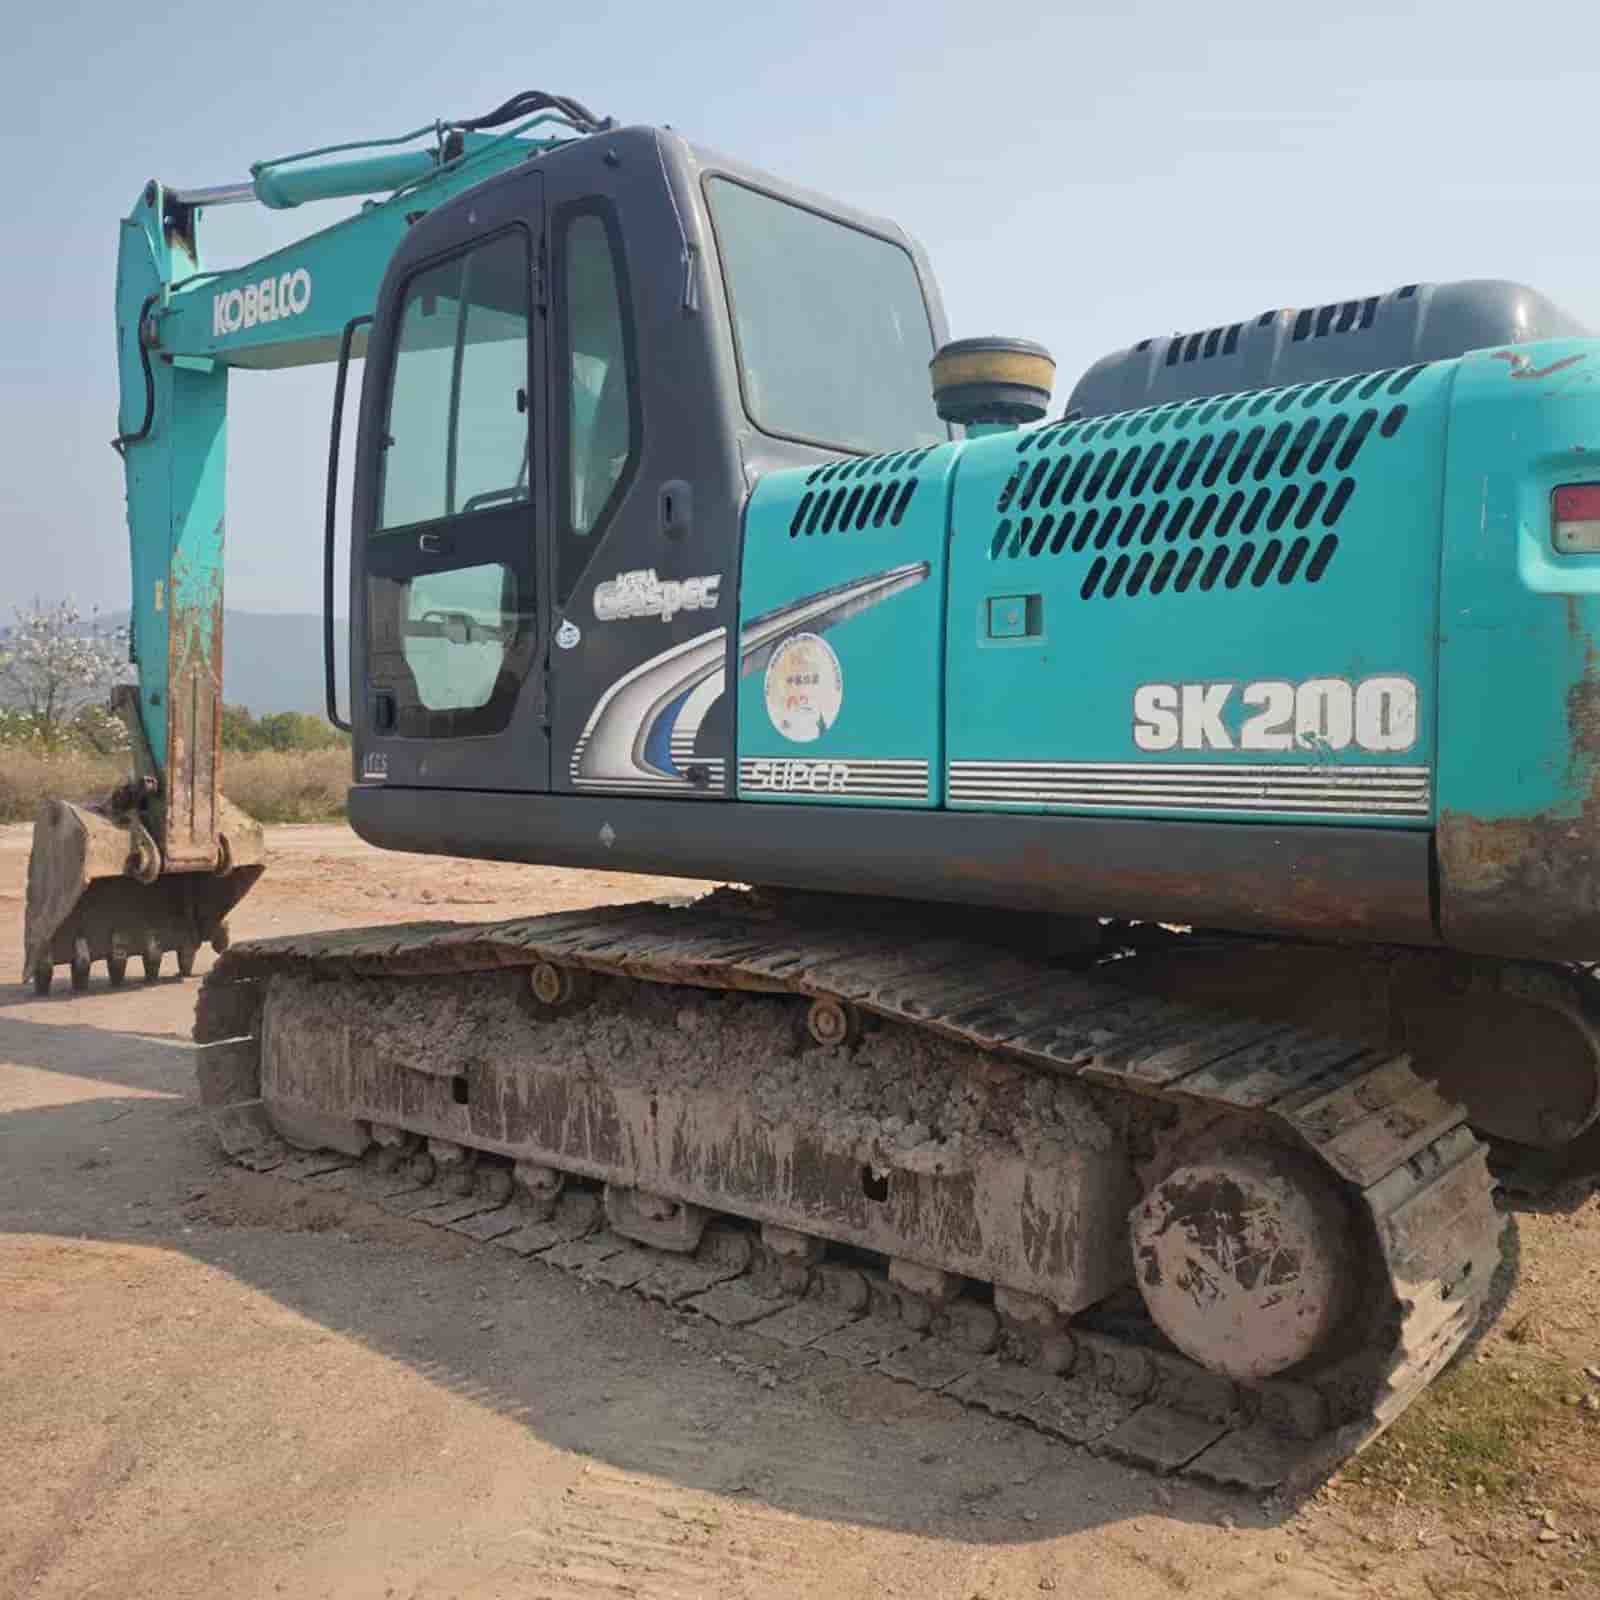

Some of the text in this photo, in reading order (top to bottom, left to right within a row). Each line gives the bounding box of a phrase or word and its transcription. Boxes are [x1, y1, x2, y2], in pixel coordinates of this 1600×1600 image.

[213, 268, 312, 336] KOBELCO
[1133, 677, 1417, 751] SK200
[752, 763, 849, 792] SUPER
